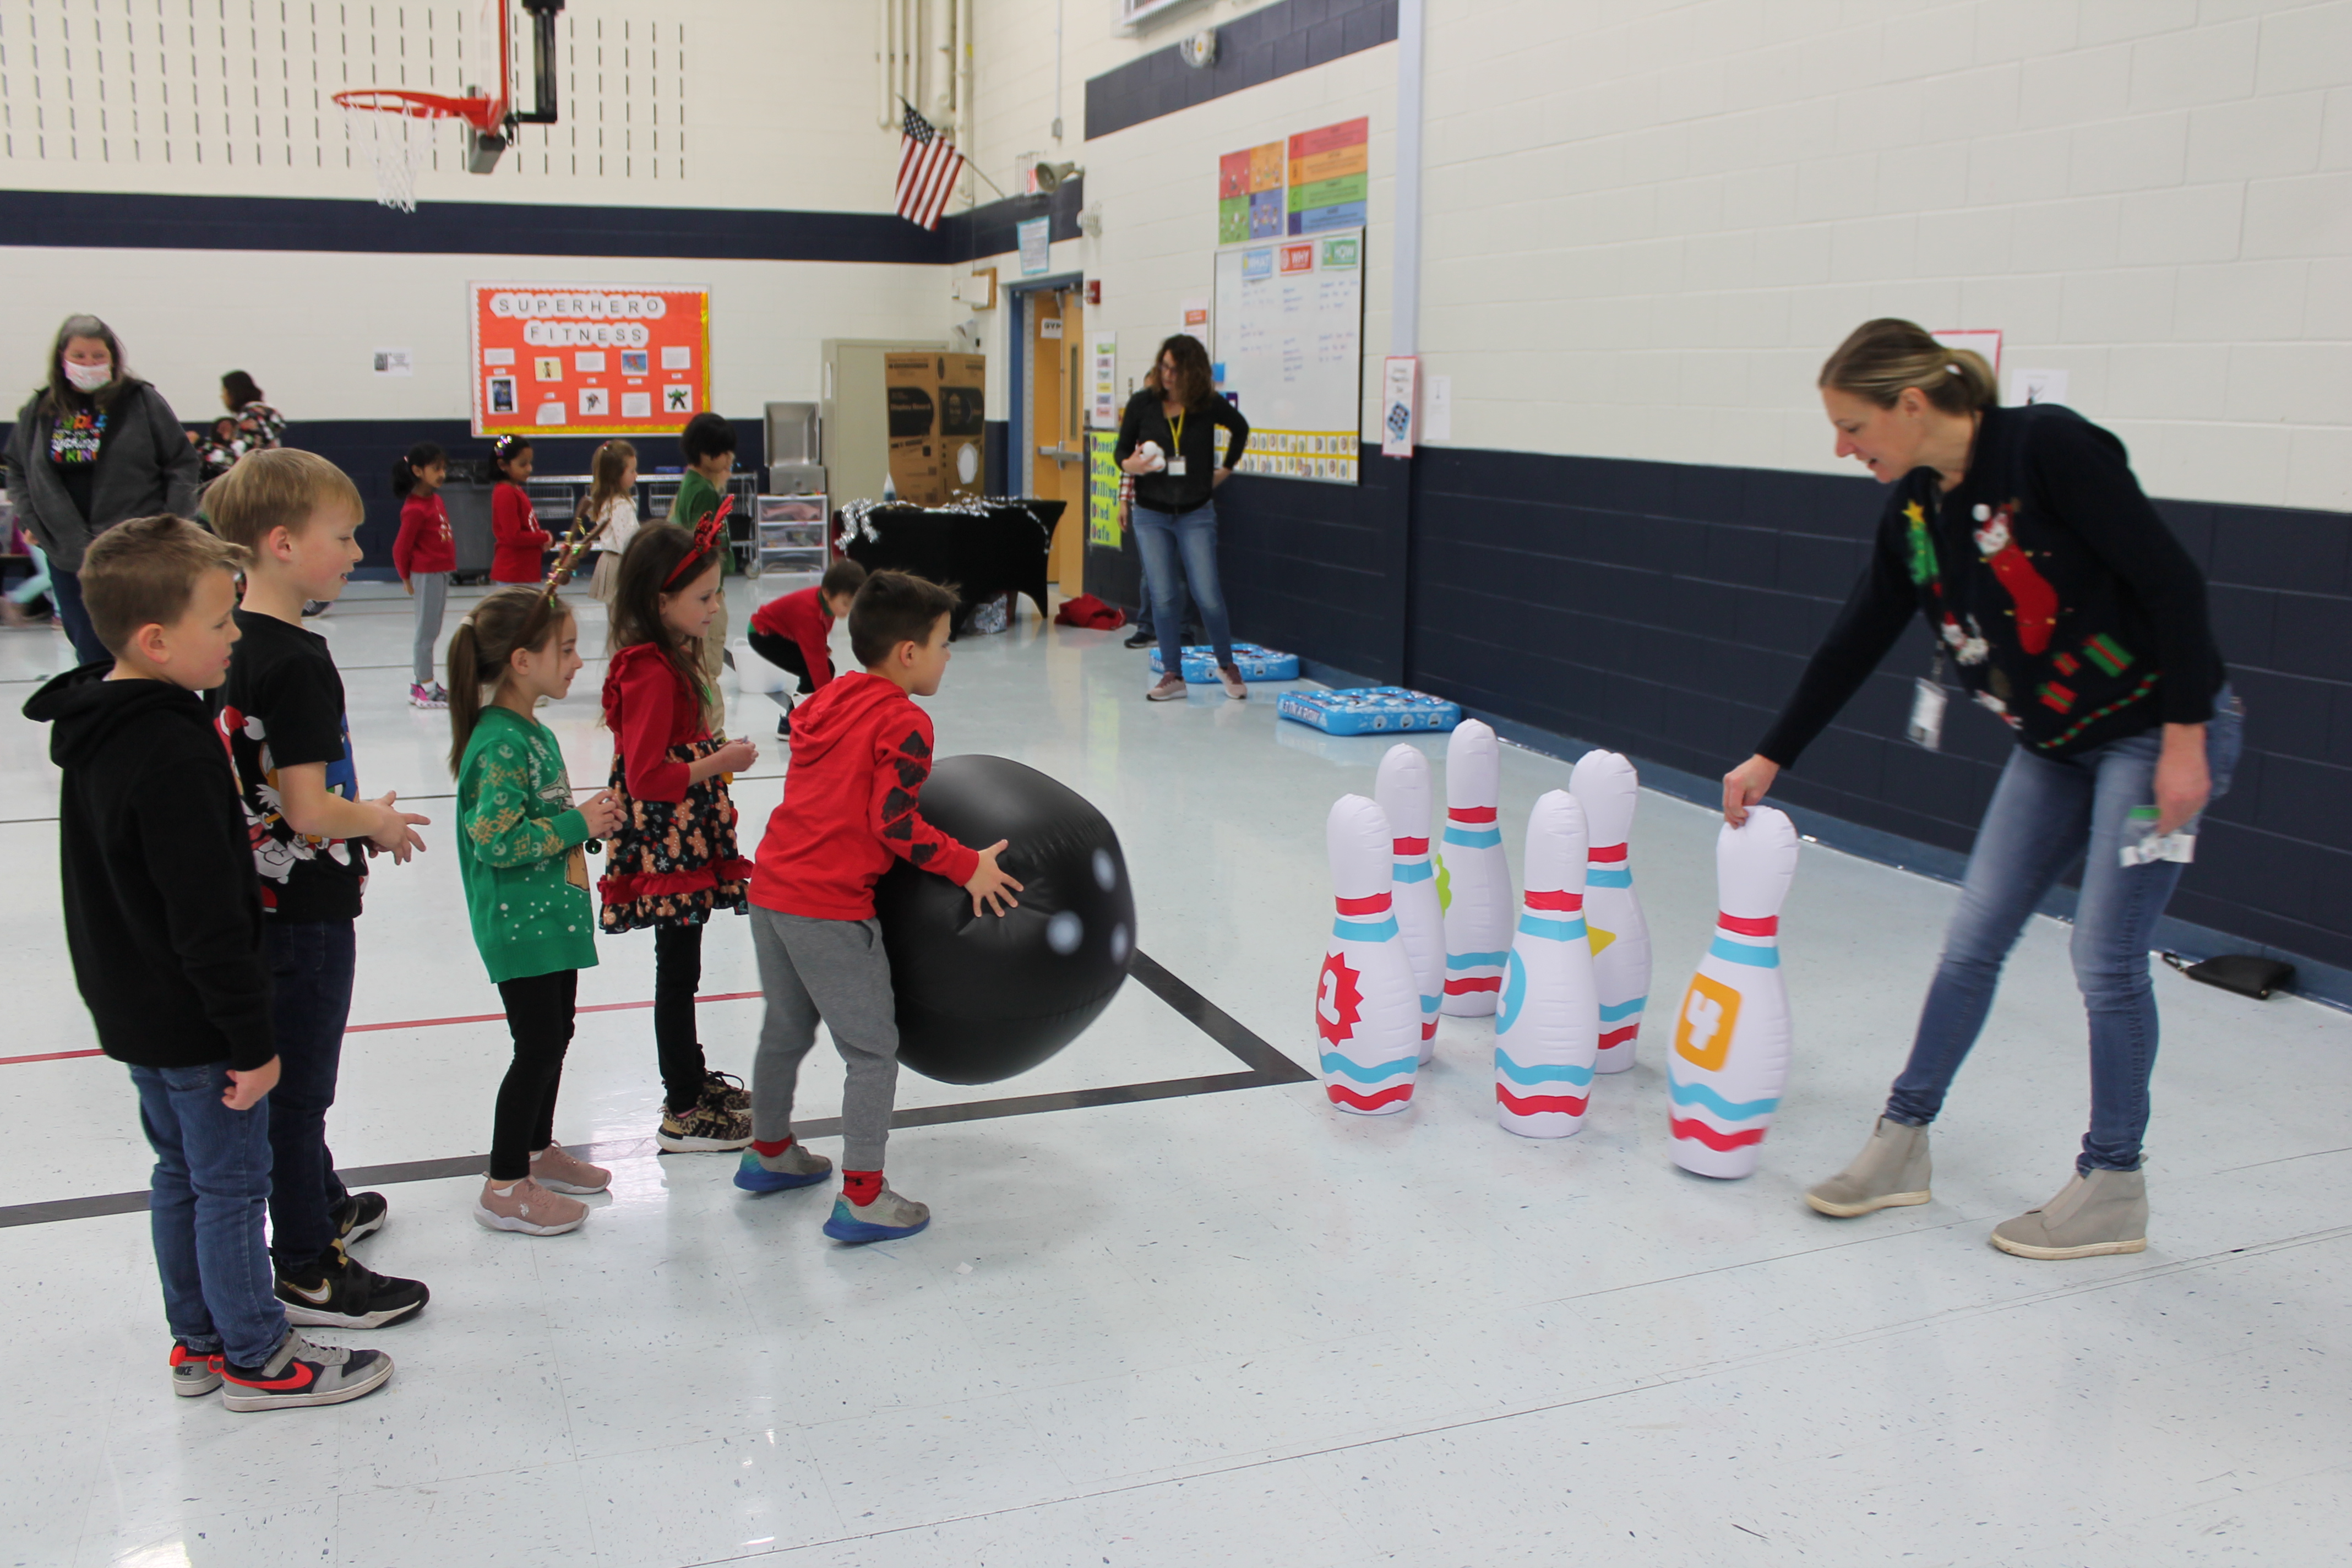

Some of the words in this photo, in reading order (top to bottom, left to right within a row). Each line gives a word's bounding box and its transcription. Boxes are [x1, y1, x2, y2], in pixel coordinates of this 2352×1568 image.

[499, 298, 658, 314] SUPERHERO
[530, 325, 641, 340] FITNESS
[1318, 969, 1341, 1026] 1
[1686, 989, 1724, 1051] 4
[175, 1365, 194, 1375] NIKE
